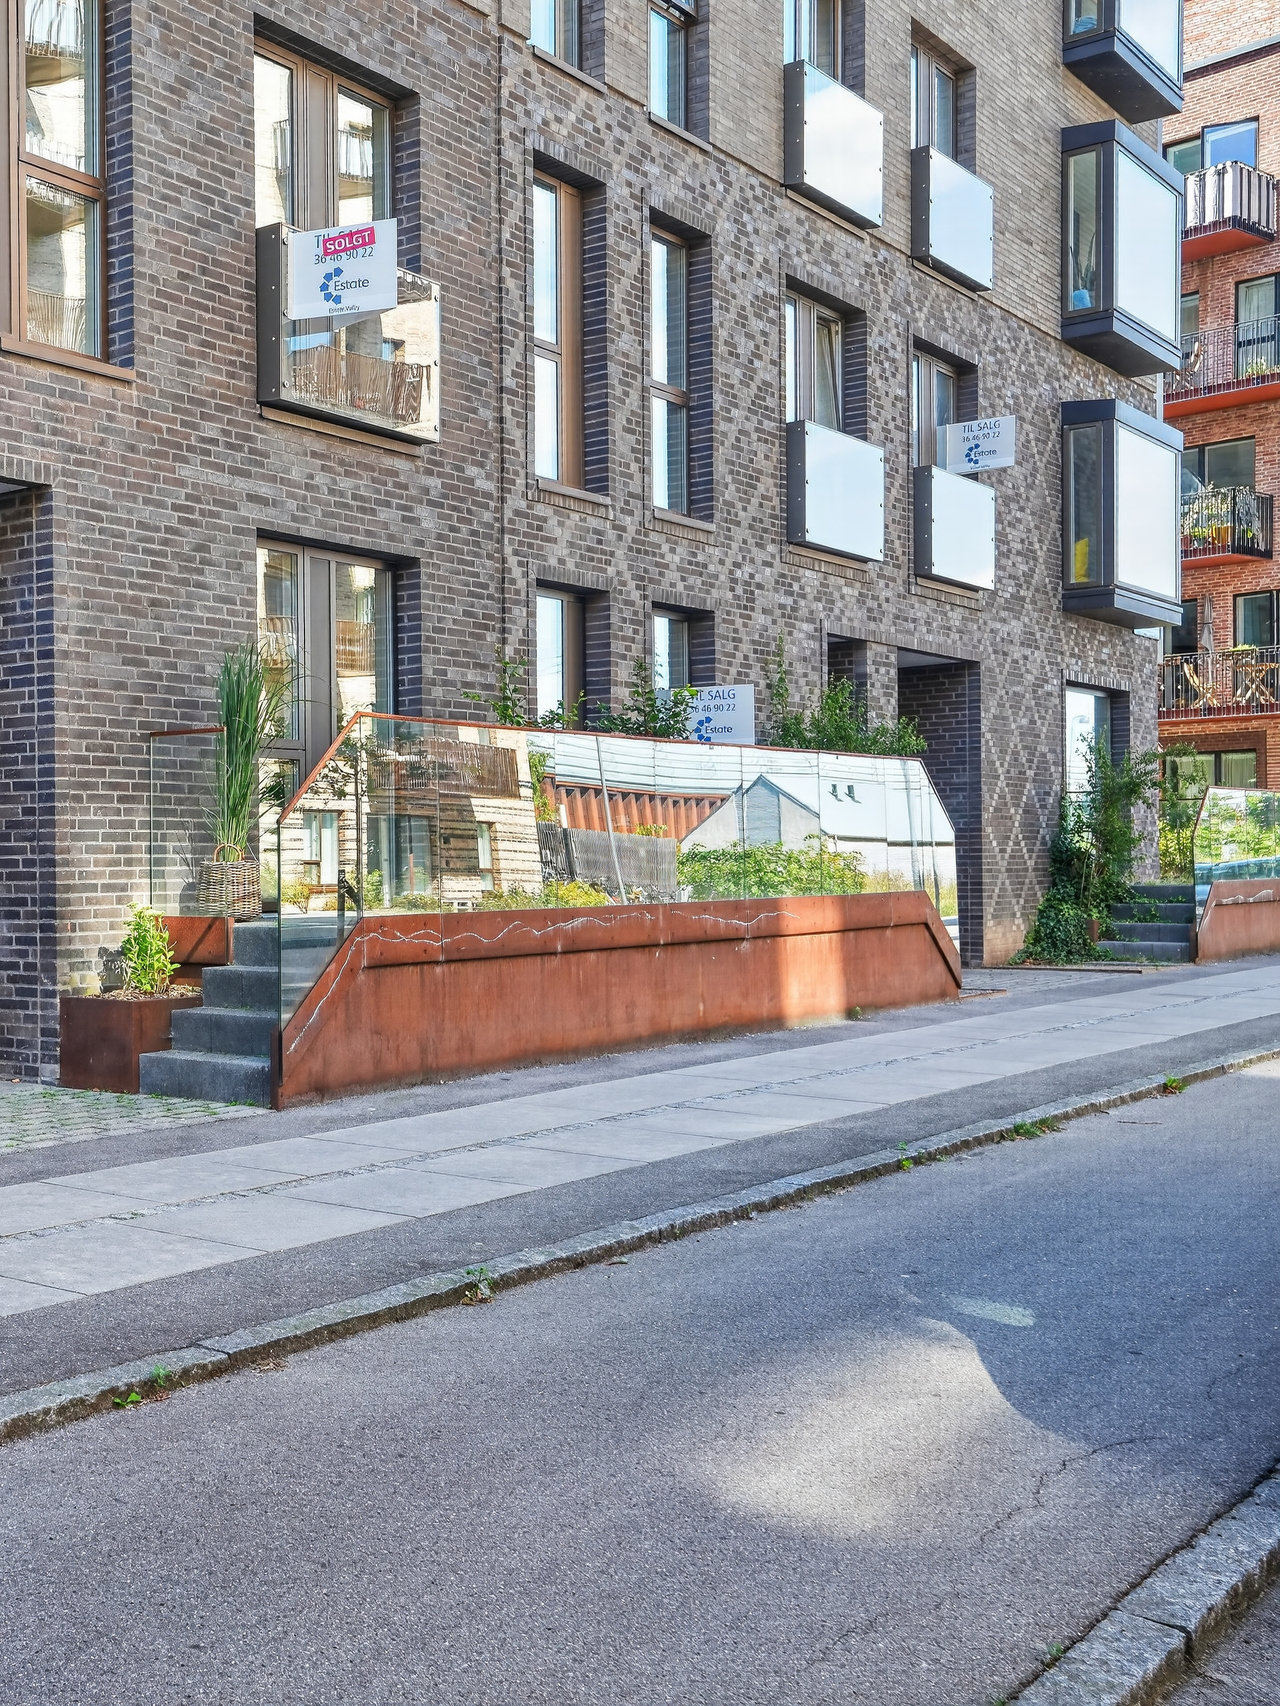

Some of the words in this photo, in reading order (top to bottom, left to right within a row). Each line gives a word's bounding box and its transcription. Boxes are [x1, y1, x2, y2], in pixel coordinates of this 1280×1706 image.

[326, 231, 371, 252] SOLGT
[314, 254, 327, 265] 36
[345, 249, 359, 260] 90
[361, 246, 374, 258] 22
[334, 278, 370, 291] Estate
[962, 424, 975, 434] TIL
[977, 420, 1001, 432] SALG
[974, 449, 998, 458] Estate
[707, 689, 736, 701] SALG
[701, 704, 712, 713] 46
[713, 703, 724, 712] 90
[726, 703, 736, 712] 22
[705, 725, 733, 734] Estate
